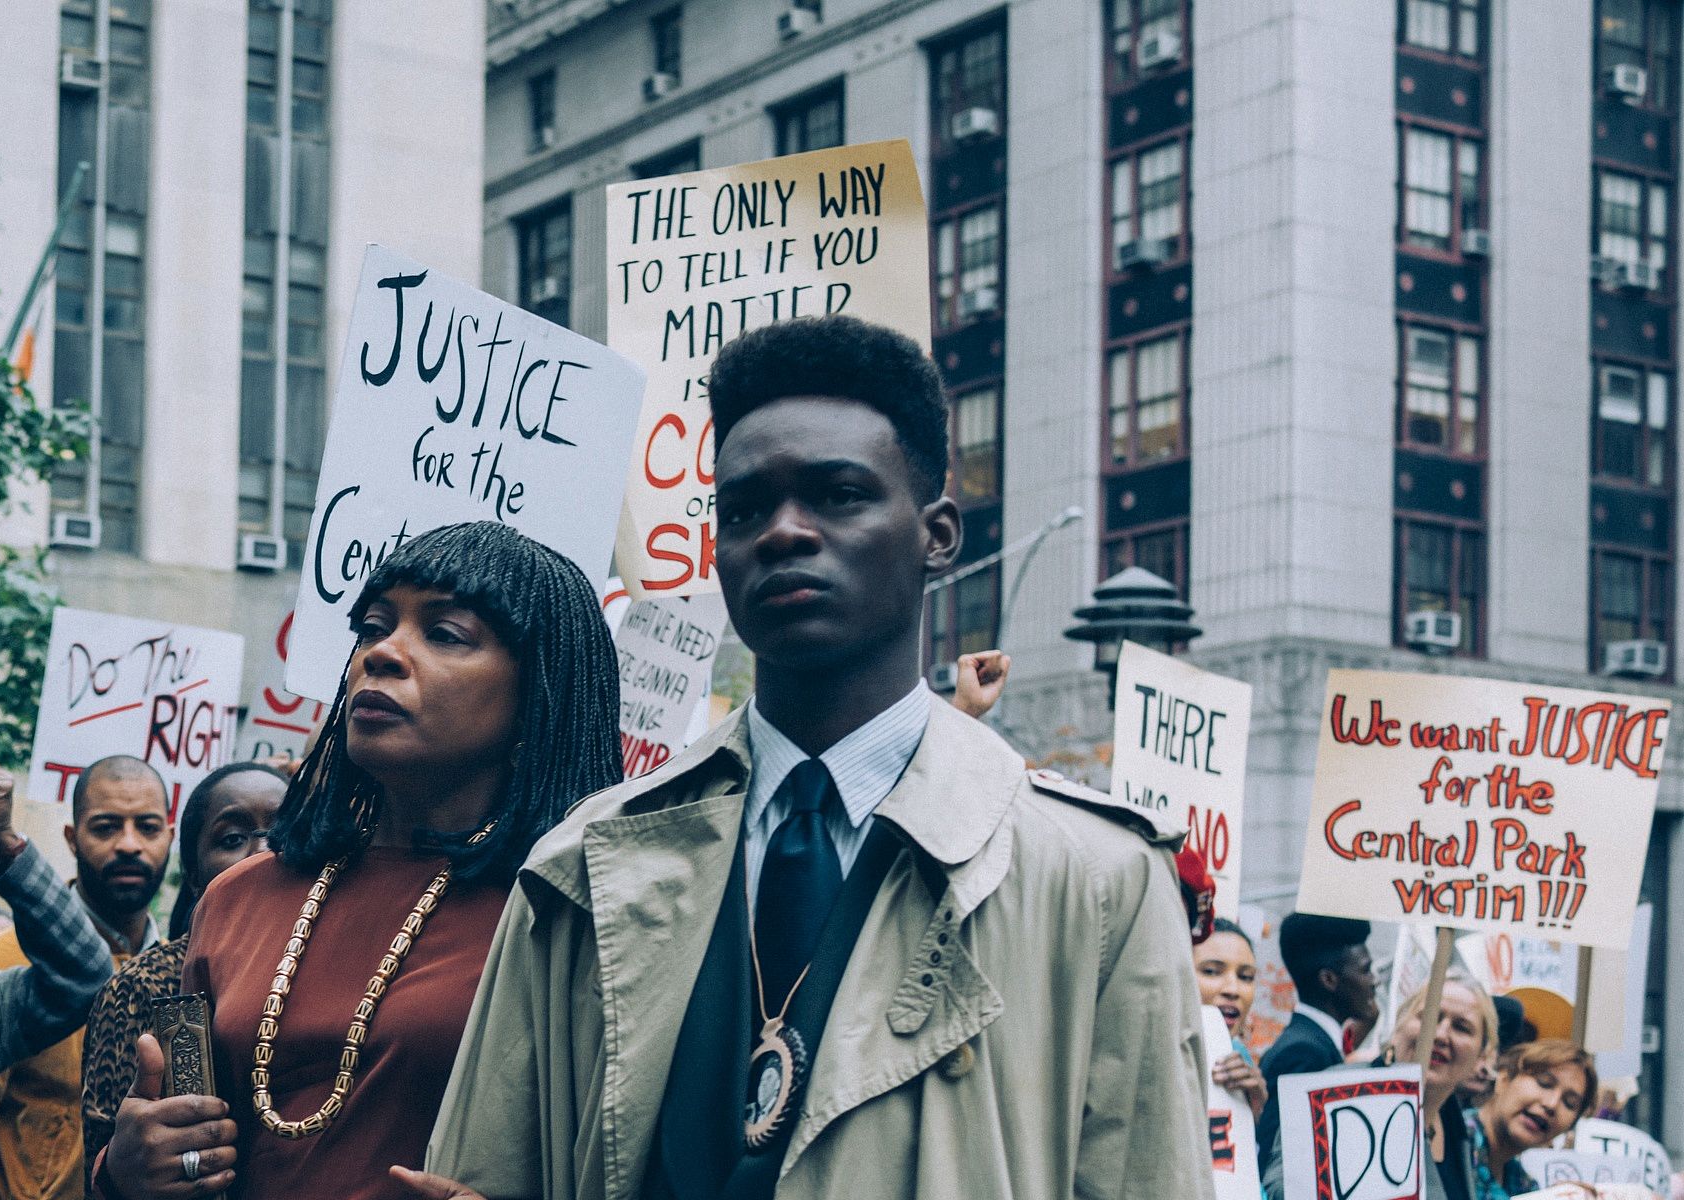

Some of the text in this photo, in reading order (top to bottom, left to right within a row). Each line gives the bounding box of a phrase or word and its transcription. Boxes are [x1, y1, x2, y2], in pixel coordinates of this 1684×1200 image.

[627, 162, 887, 245] THE ONLY WAY
[617, 225, 879, 305] TO TELL IF YOU
[359, 268, 593, 447] JUSTICE
[469, 441, 526, 522] the
[641, 522, 718, 591] SK
[68, 643, 123, 711] Do
[1134, 683, 1228, 776] THERE
[1330, 693, 1671, 779] We want JUSTICE
[1419, 756, 1556, 816] for the
[1187, 804, 1230, 872] NO
[1323, 800, 1588, 880] Central Park
[1537, 880, 1588, 930] !!!
